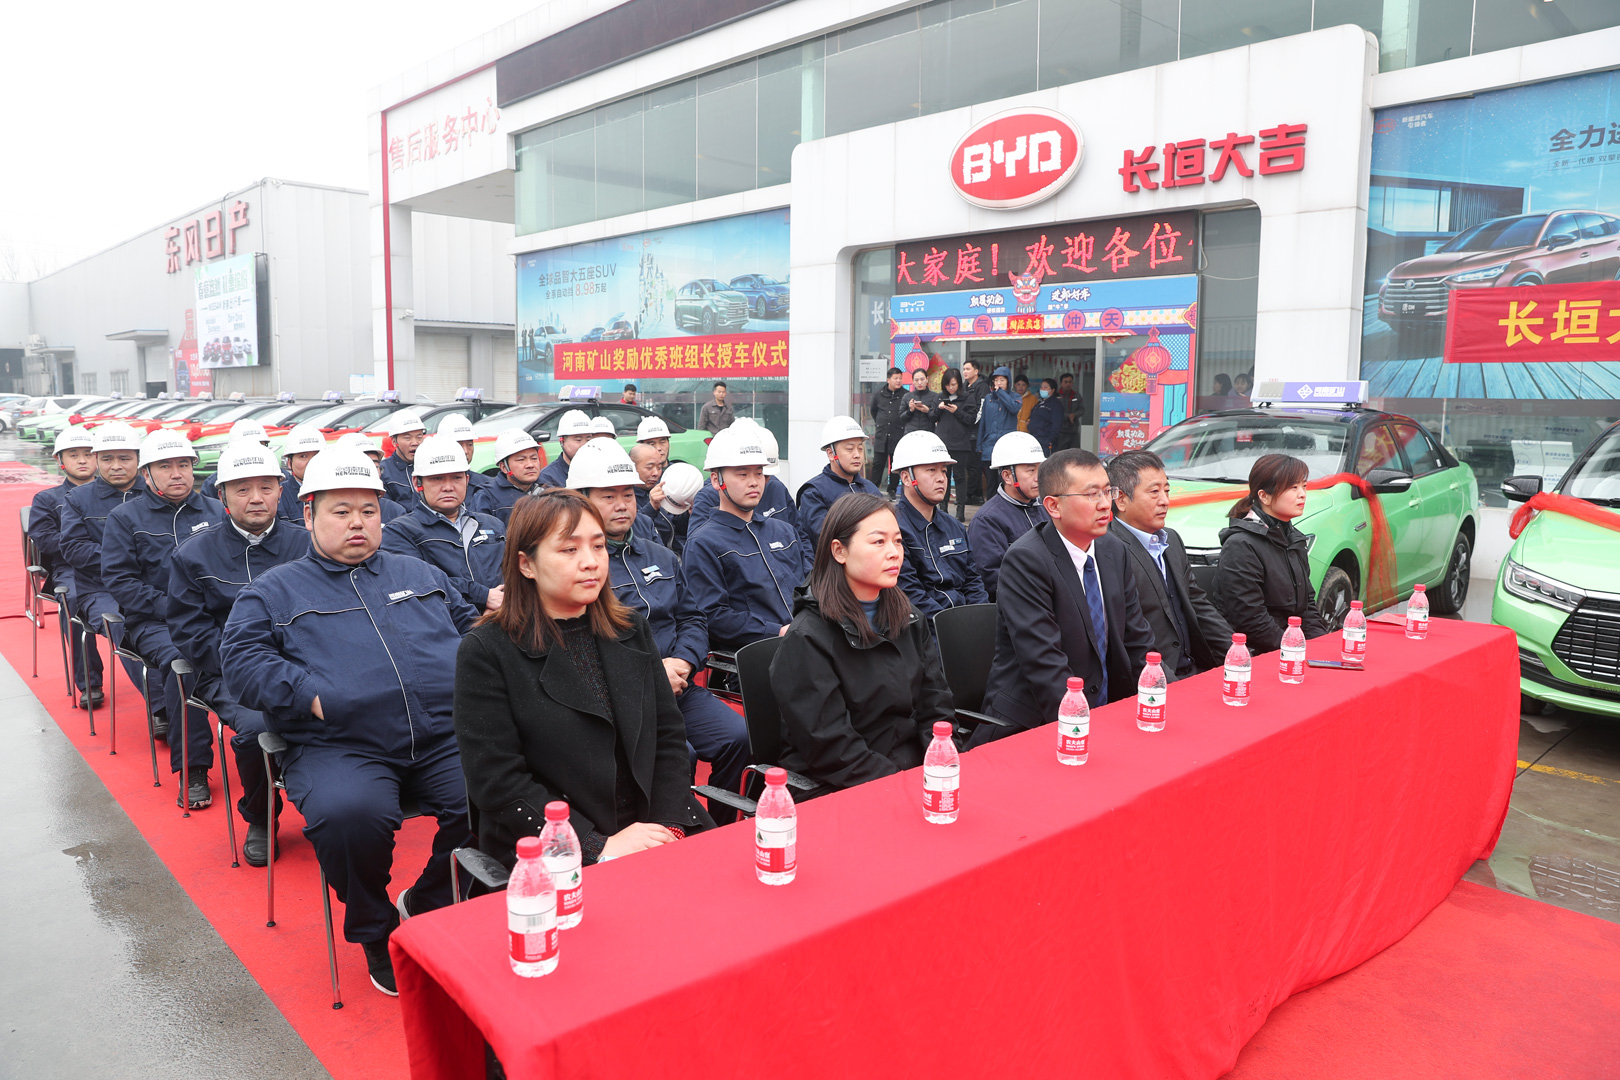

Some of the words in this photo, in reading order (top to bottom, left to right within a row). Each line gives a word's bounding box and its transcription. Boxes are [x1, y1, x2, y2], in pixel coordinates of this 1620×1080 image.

[389, 96, 501, 173] 售后服务中心
[962, 130, 1063, 184] BYD
[1118, 123, 1308, 193] 长垣大吉
[164, 200, 250, 274] 东风日产
[897, 222, 1193, 286] 大家庭！欢迎各位
[538, 263, 617, 288] 全球品智大五座SUV
[575, 281, 607, 297] 8.98万起
[900, 300, 925, 308] BYD
[562, 340, 788, 372] 河南矿山奖励优秀班组长授车仪式
